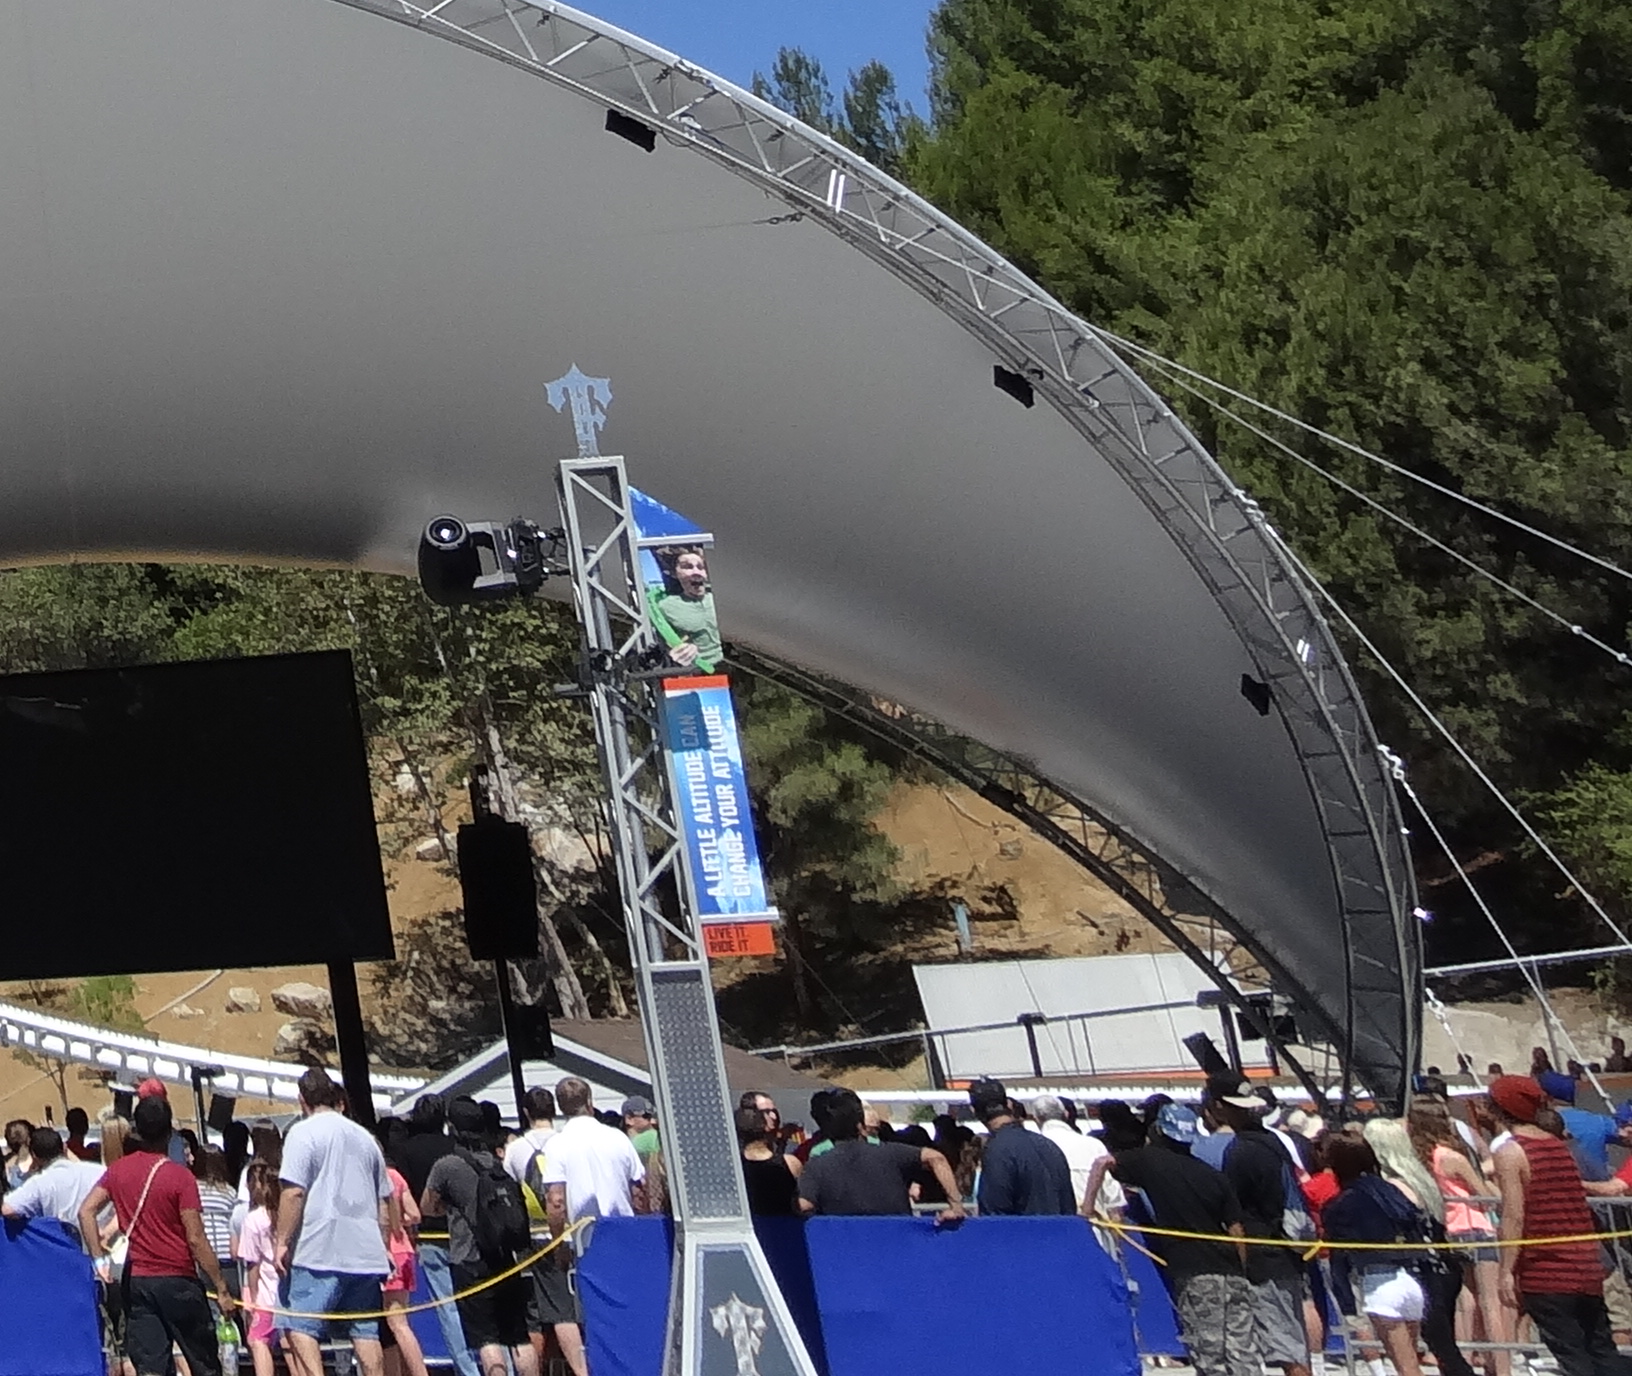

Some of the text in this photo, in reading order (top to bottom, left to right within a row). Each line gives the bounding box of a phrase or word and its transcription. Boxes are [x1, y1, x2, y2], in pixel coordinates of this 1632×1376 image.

[679, 713, 726, 898] A LITTLE ALTITUDE CAN
[702, 705, 751, 897] CHANGE YOUR ATTITUDE
[707, 927, 734, 940] LIVE
[709, 940, 735, 953] RIDE
